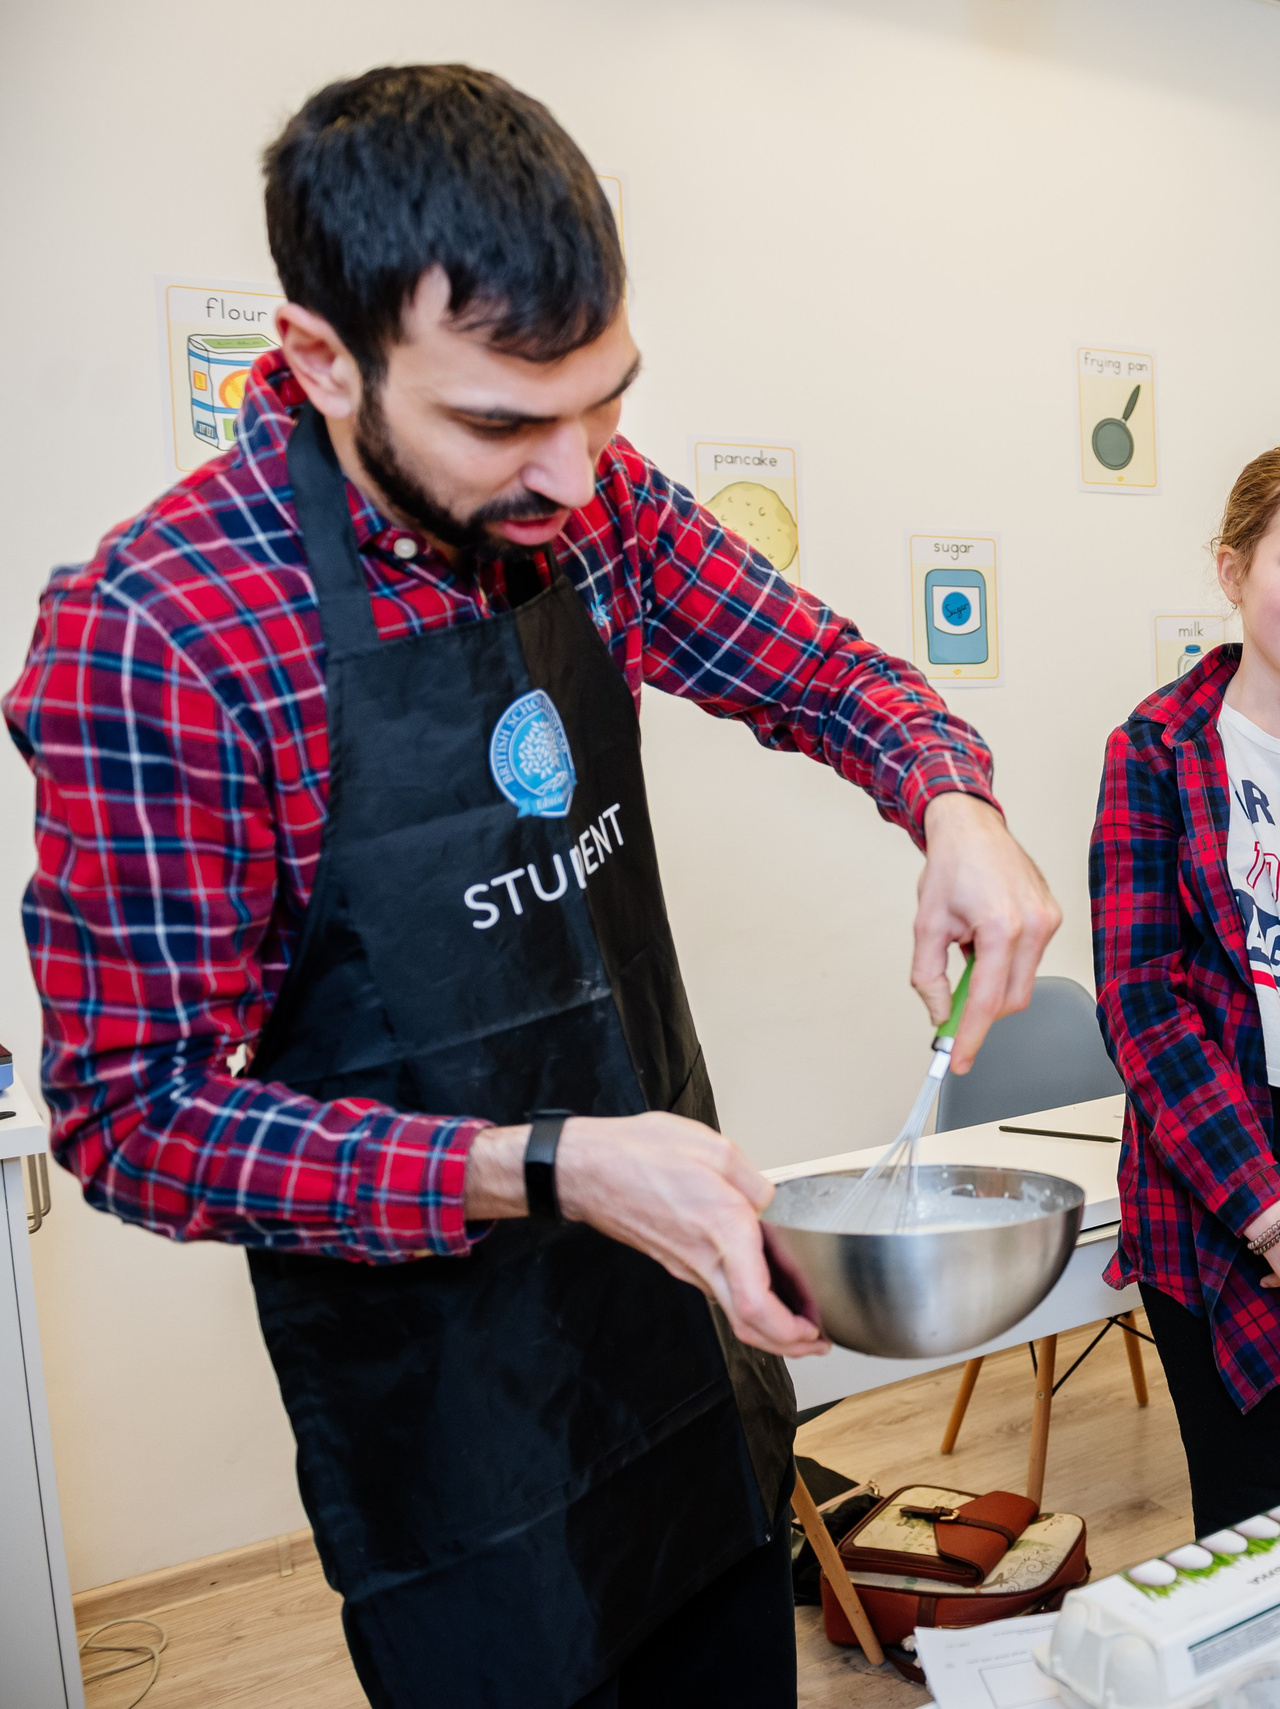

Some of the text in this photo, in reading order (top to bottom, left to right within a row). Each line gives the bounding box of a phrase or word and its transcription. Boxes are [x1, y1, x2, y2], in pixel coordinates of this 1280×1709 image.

[205, 297, 268, 322] flour
[1084, 351, 1149, 375] frying pan
[713, 450, 778, 471] pancake
[933, 542, 974, 561] sugar
[945, 603, 970, 619] Sugar
[1178, 620, 1204, 637] milk
[495, 698, 542, 785] BRITISH SCHO
